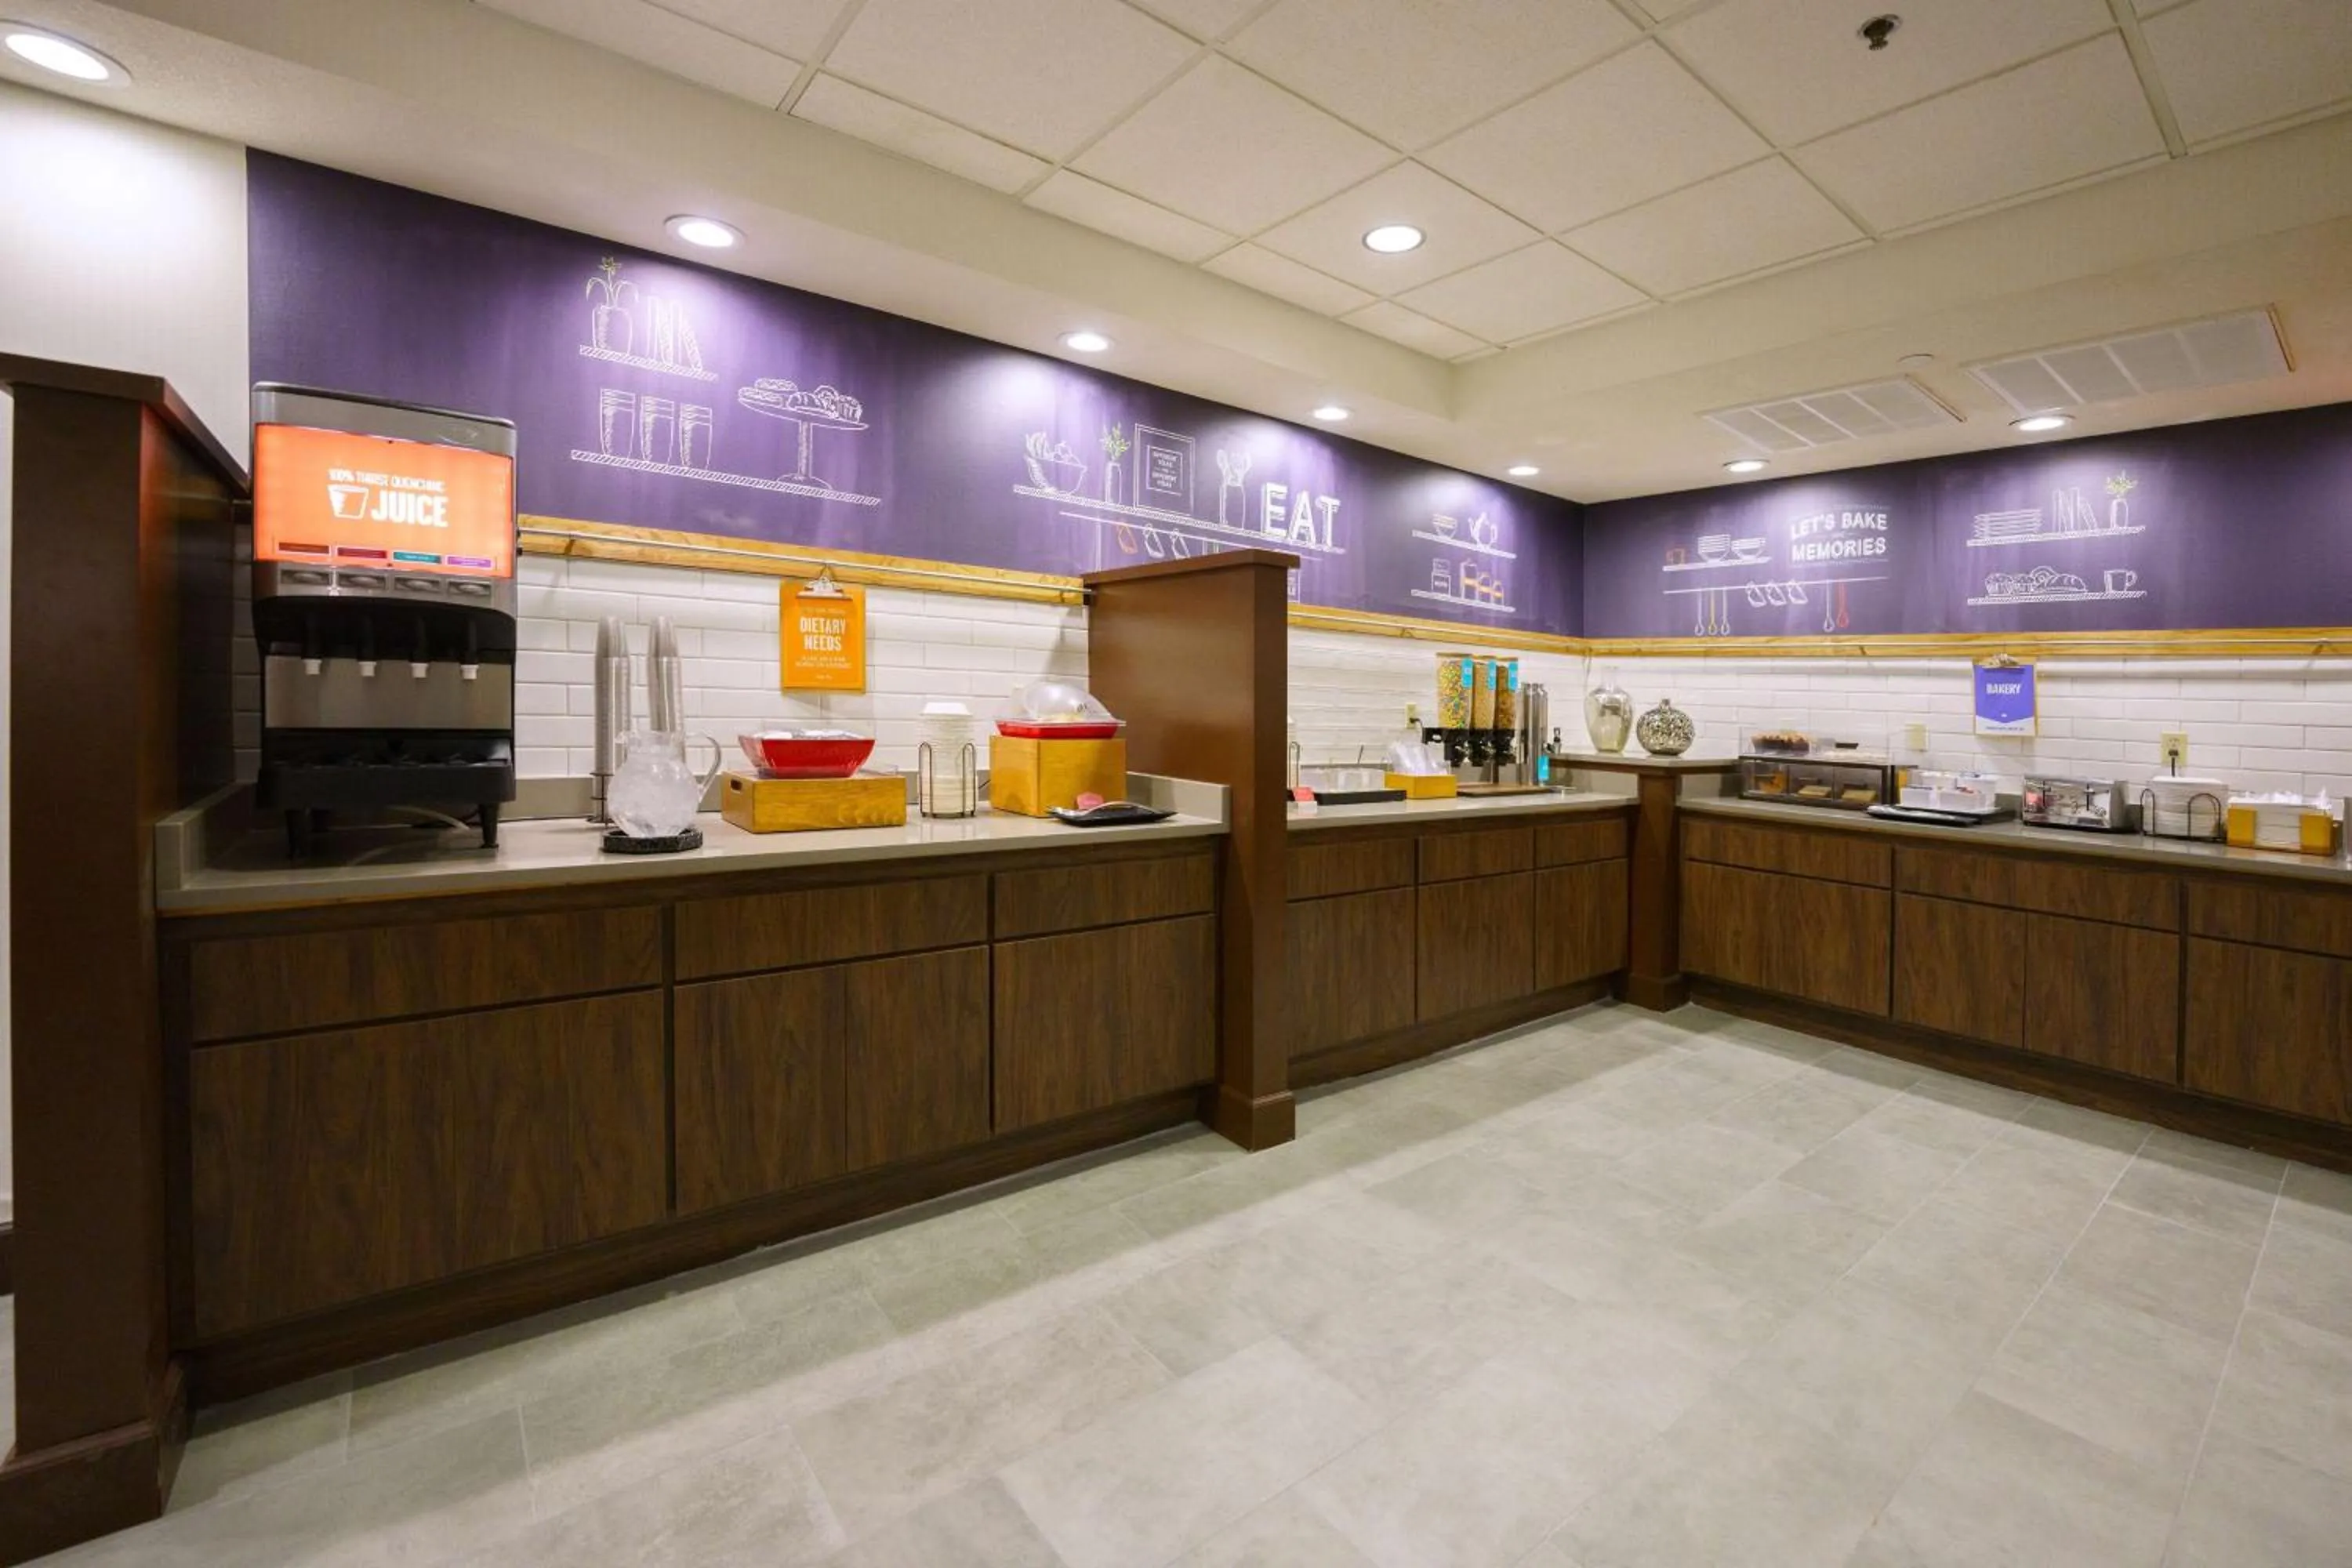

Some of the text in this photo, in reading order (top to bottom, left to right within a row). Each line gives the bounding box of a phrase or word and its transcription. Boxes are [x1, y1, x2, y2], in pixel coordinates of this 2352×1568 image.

[371, 490, 448, 528] JUICE
[1260, 482, 1341, 550] EAT
[1791, 512, 1888, 539] LET'S BAKE
[1791, 536, 1886, 562] MEMORIES
[800, 617, 846, 635] DIETARY
[804, 634, 841, 652] NEEDS
[1986, 683, 2021, 695] BAKERY
